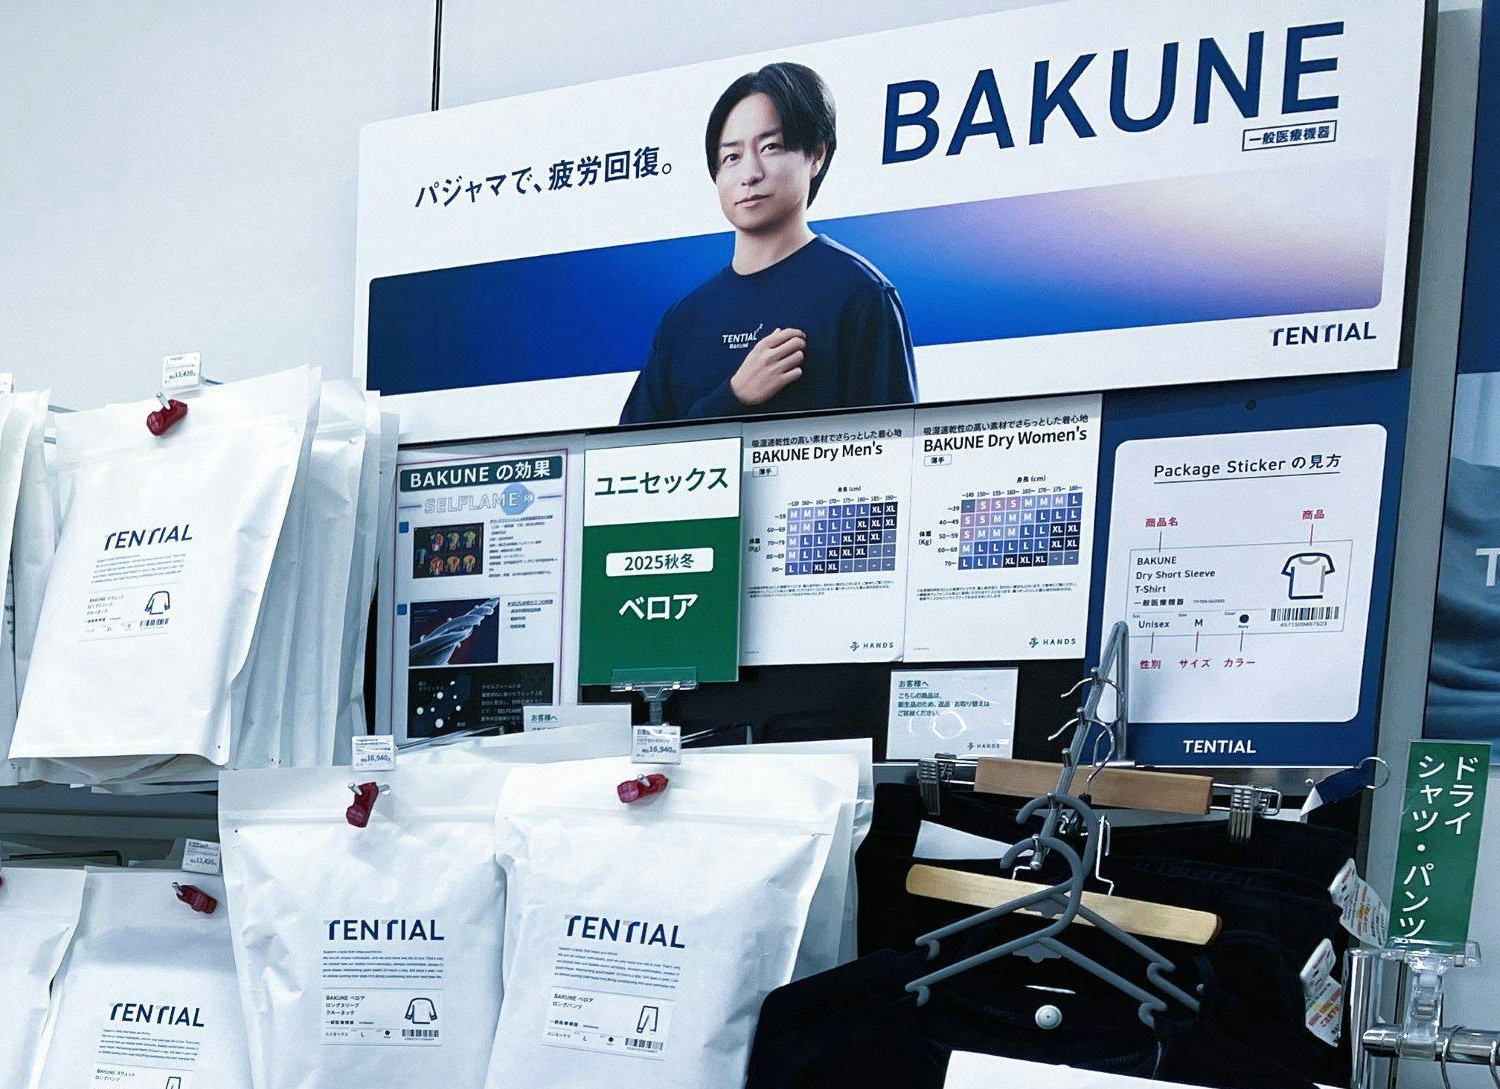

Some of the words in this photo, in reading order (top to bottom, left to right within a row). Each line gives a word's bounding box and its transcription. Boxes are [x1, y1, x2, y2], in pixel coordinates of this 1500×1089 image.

[881, 21, 1345, 165] BAKUNE
[1249, 126, 1329, 144] 一般医療機器
[416, 142, 675, 210] パジャマで、疲労回復。
[722, 331, 757, 343] TENTIAL
[1268, 320, 1377, 348] TENTIAL
[923, 414, 1089, 435] 吸湿速乾性の高い素材でさらっとした着心地
[752, 429, 902, 447] 吸湿速乾性の高い素材でさらっとした着心地
[924, 437, 984, 453] BAKUNE
[988, 433, 1015, 450] Dry
[1018, 428, 1087, 446] Women's
[752, 447, 809, 463] BAKUNE
[814, 446, 838, 461] Dry
[842, 441, 883, 457] Men's
[410, 466, 489, 488] BAKUNE
[497, 459, 550, 481] の効果
[1154, 462, 1220, 479] Package
[1227, 458, 1286, 474] Sticker
[1292, 453, 1341, 469] の見方
[594, 466, 729, 497] ユニセックス
[1145, 517, 1178, 528] 商品名
[1302, 510, 1325, 520] 商品
[104, 524, 193, 551] TENTIAL
[624, 555, 694, 572] 2025秋冬
[963, 559, 968, 567] L
[1005, 556, 1015, 565] XL
[1020, 556, 1030, 564] XL
[1035, 555, 1046, 563] XL
[1137, 556, 1177, 565] BAKUNE
[1136, 572, 1152, 581] Dry
[1156, 570, 1181, 579] Short
[1185, 569, 1215, 578] Sleeve
[619, 593, 698, 621] ベロア
[1138, 620, 1170, 629] Unisex
[1195, 619, 1203, 627] M
[863, 641, 893, 649] HANDS
[1043, 638, 1076, 646] HANDS
[1140, 659, 1161, 669] 性別
[1179, 658, 1212, 668] サイズ
[1224, 658, 1255, 668] カラー
[1183, 740, 1257, 754] TENTIAL
[1444, 756, 1480, 835] ドライ
[1399, 755, 1446, 939] シャツ・パンツ
[324, 920, 444, 940] TENTIAL
[564, 915, 685, 949] TENTIAL
[109, 1002, 205, 1028] TENTIAL
